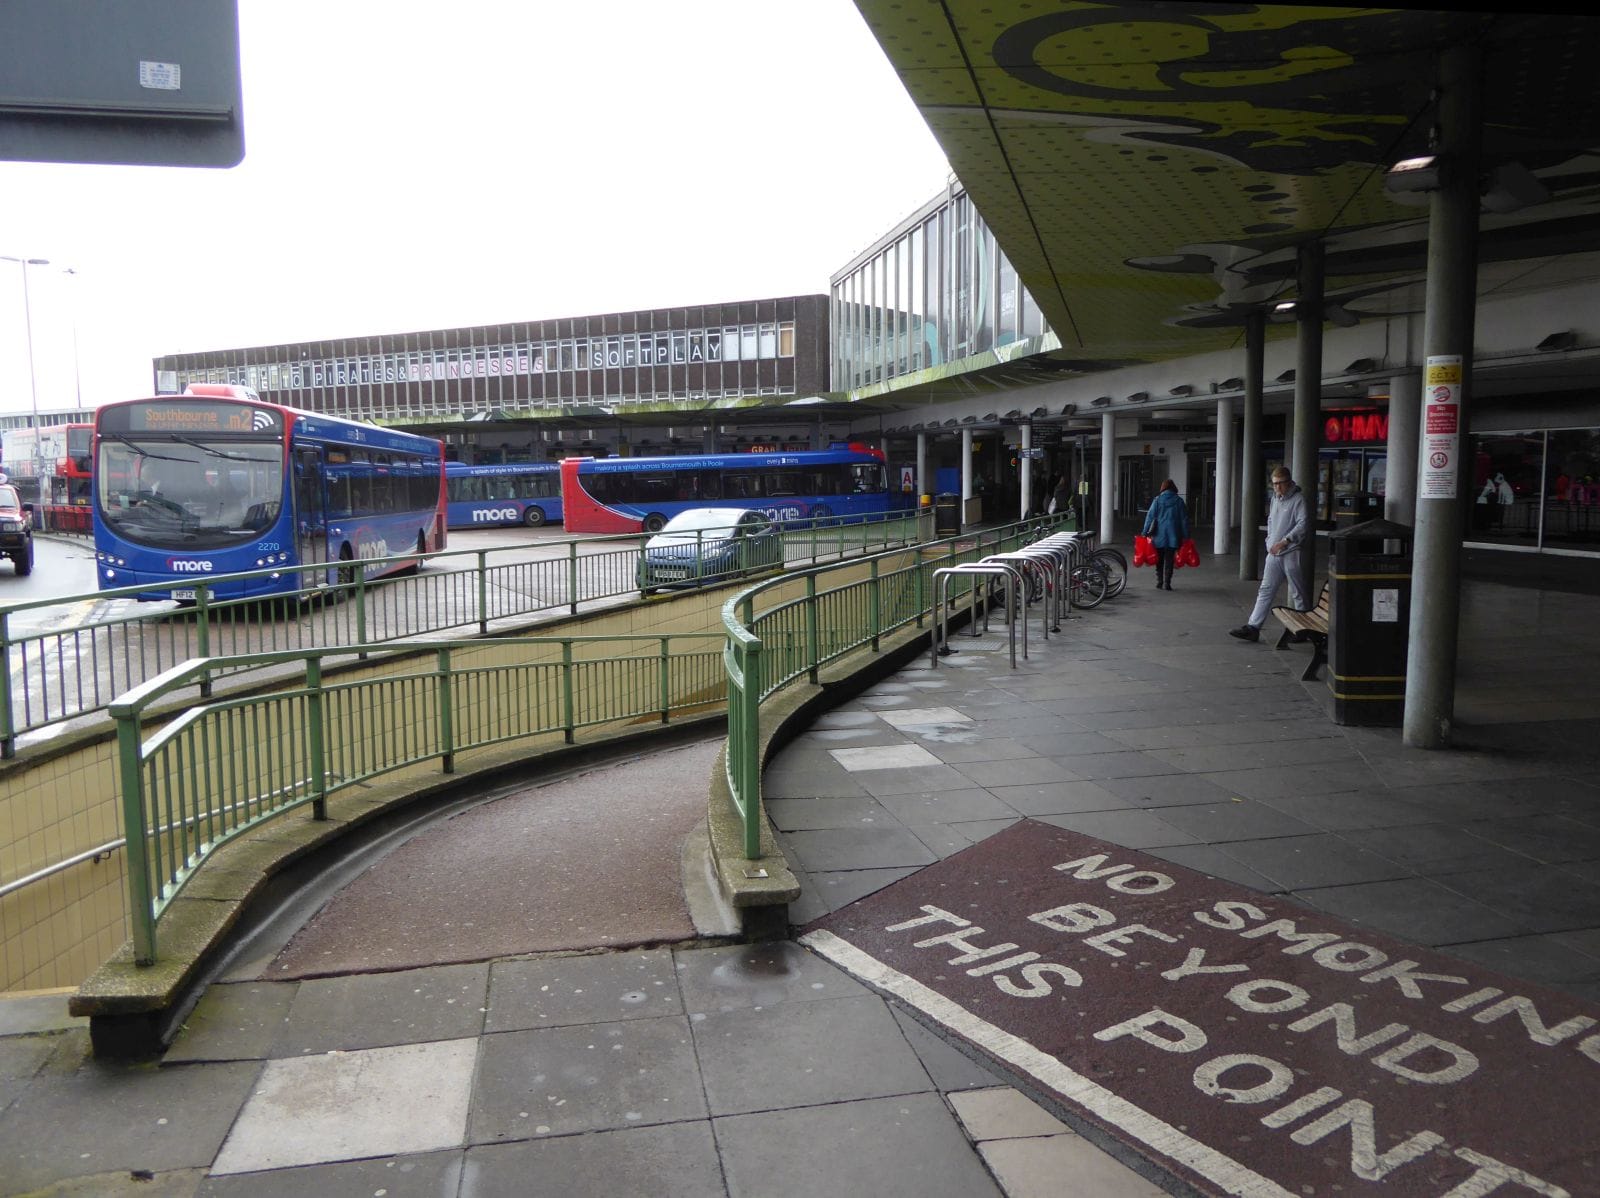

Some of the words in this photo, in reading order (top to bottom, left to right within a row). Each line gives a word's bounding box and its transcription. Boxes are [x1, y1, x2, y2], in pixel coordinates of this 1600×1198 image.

[316, 368, 394, 387] PIRATES
[411, 356, 544, 377] PRINCESSES
[145, 409, 217, 422] Southbourne
[1343, 413, 1389, 442] HMV
[513, 465, 545, 473] Bournemouth
[661, 461, 702, 469] Bournemouth
[472, 508, 518, 522] more
[258, 543, 280, 551] 2270
[173, 560, 214, 572] more
[1052, 854, 1176, 895] NO
[1026, 902, 1480, 1085] BEYOND
[885, 904, 1083, 998] THIS
[1093, 1009, 1571, 1198] POINT
